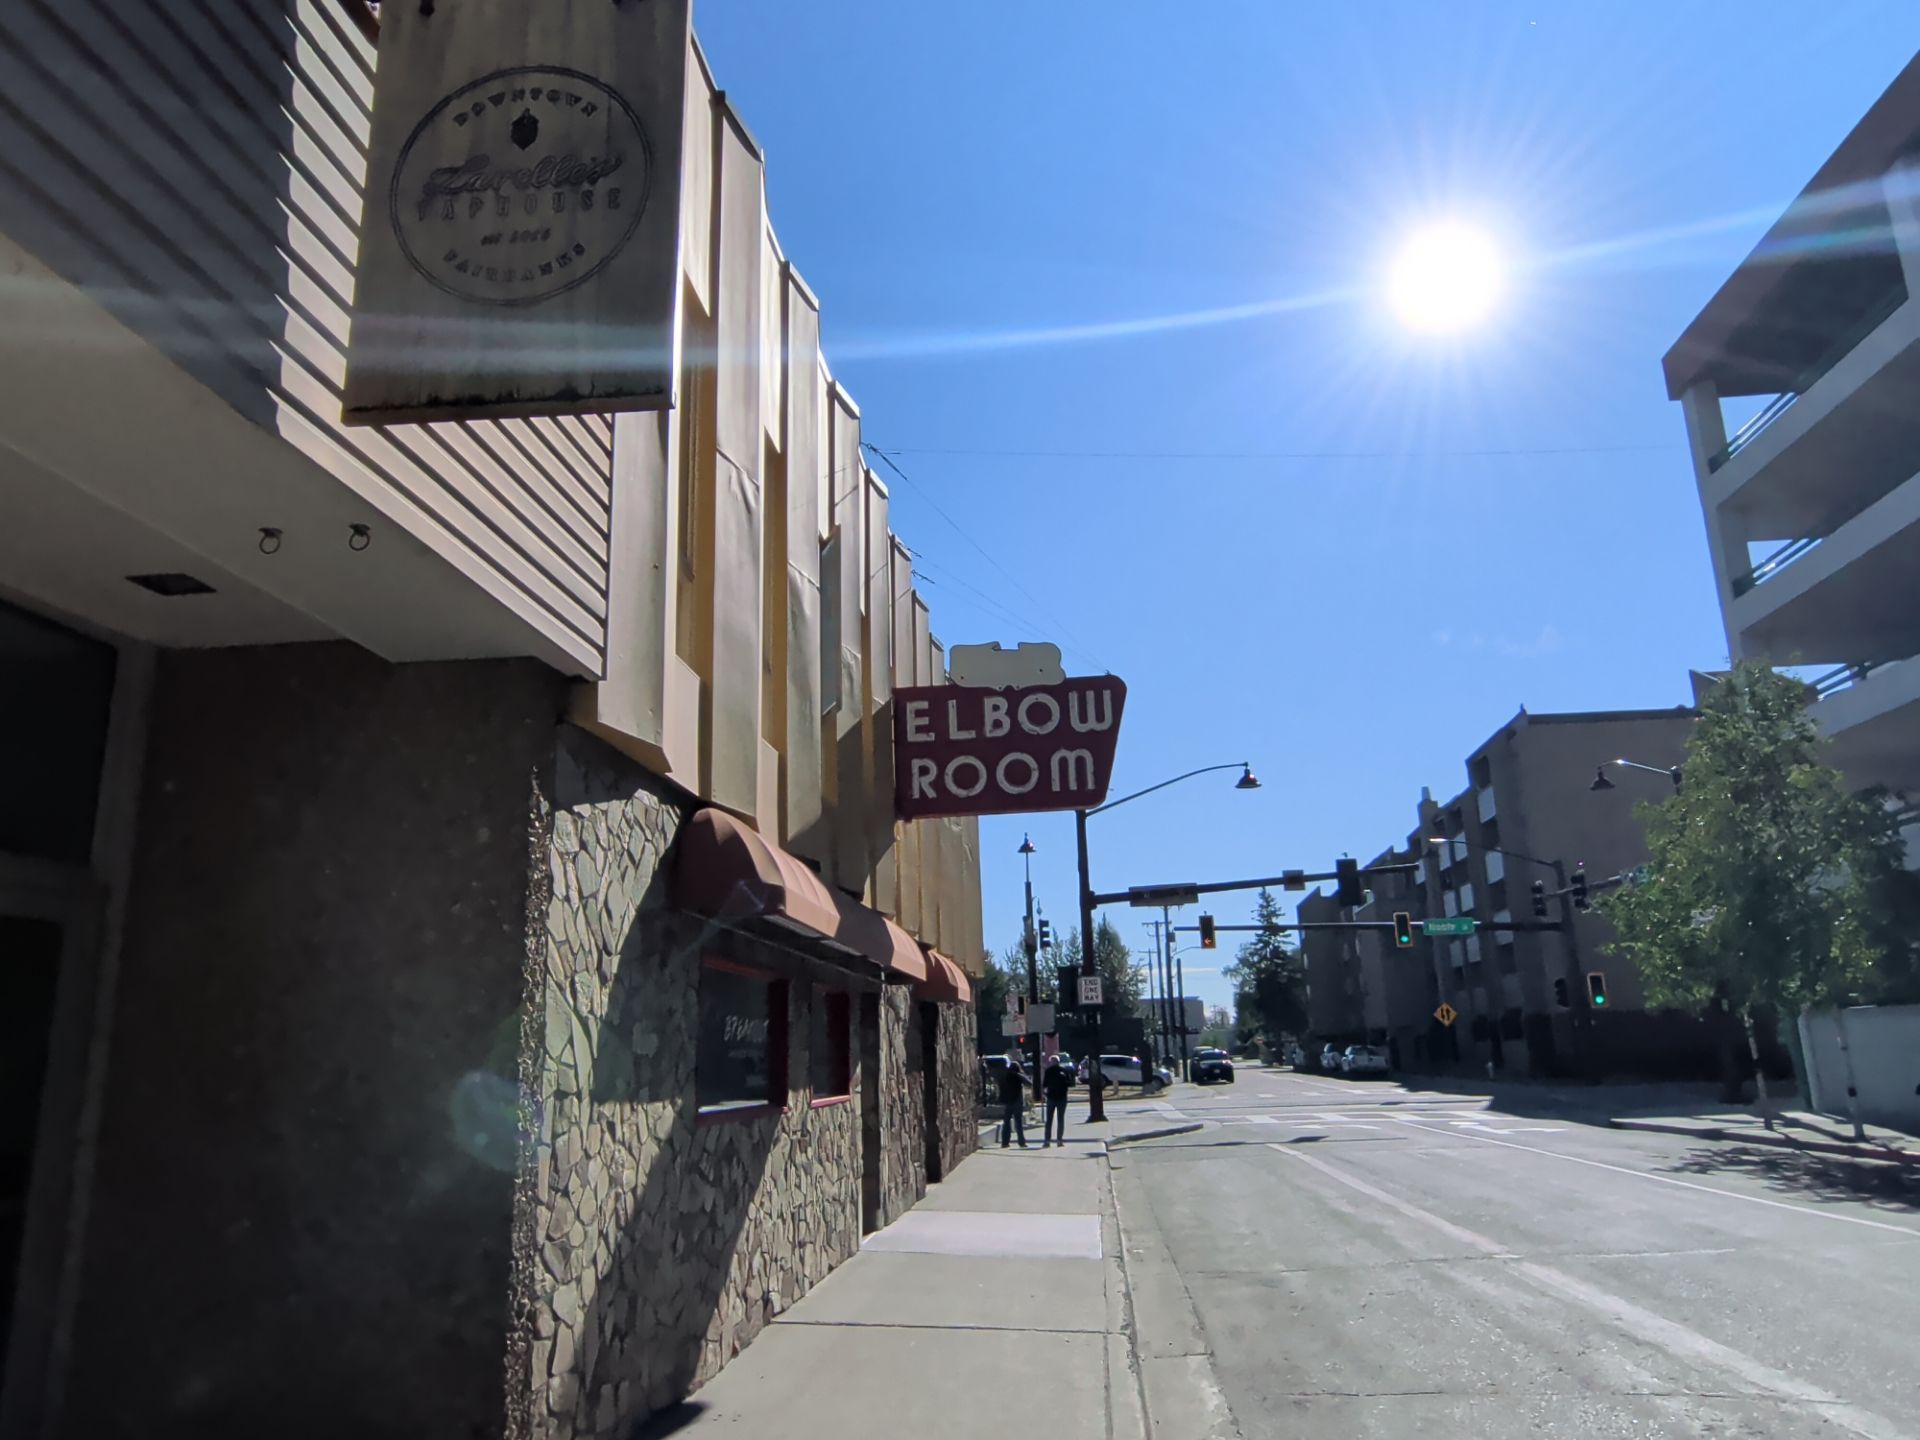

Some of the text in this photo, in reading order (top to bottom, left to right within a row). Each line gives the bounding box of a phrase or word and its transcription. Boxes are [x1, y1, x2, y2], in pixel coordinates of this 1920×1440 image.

[452, 87, 599, 127] DOWNTOWN
[417, 188, 622, 221] TAPHOUSE
[906, 689, 1113, 742] ELBOW
[911, 748, 1096, 800] ROOM
